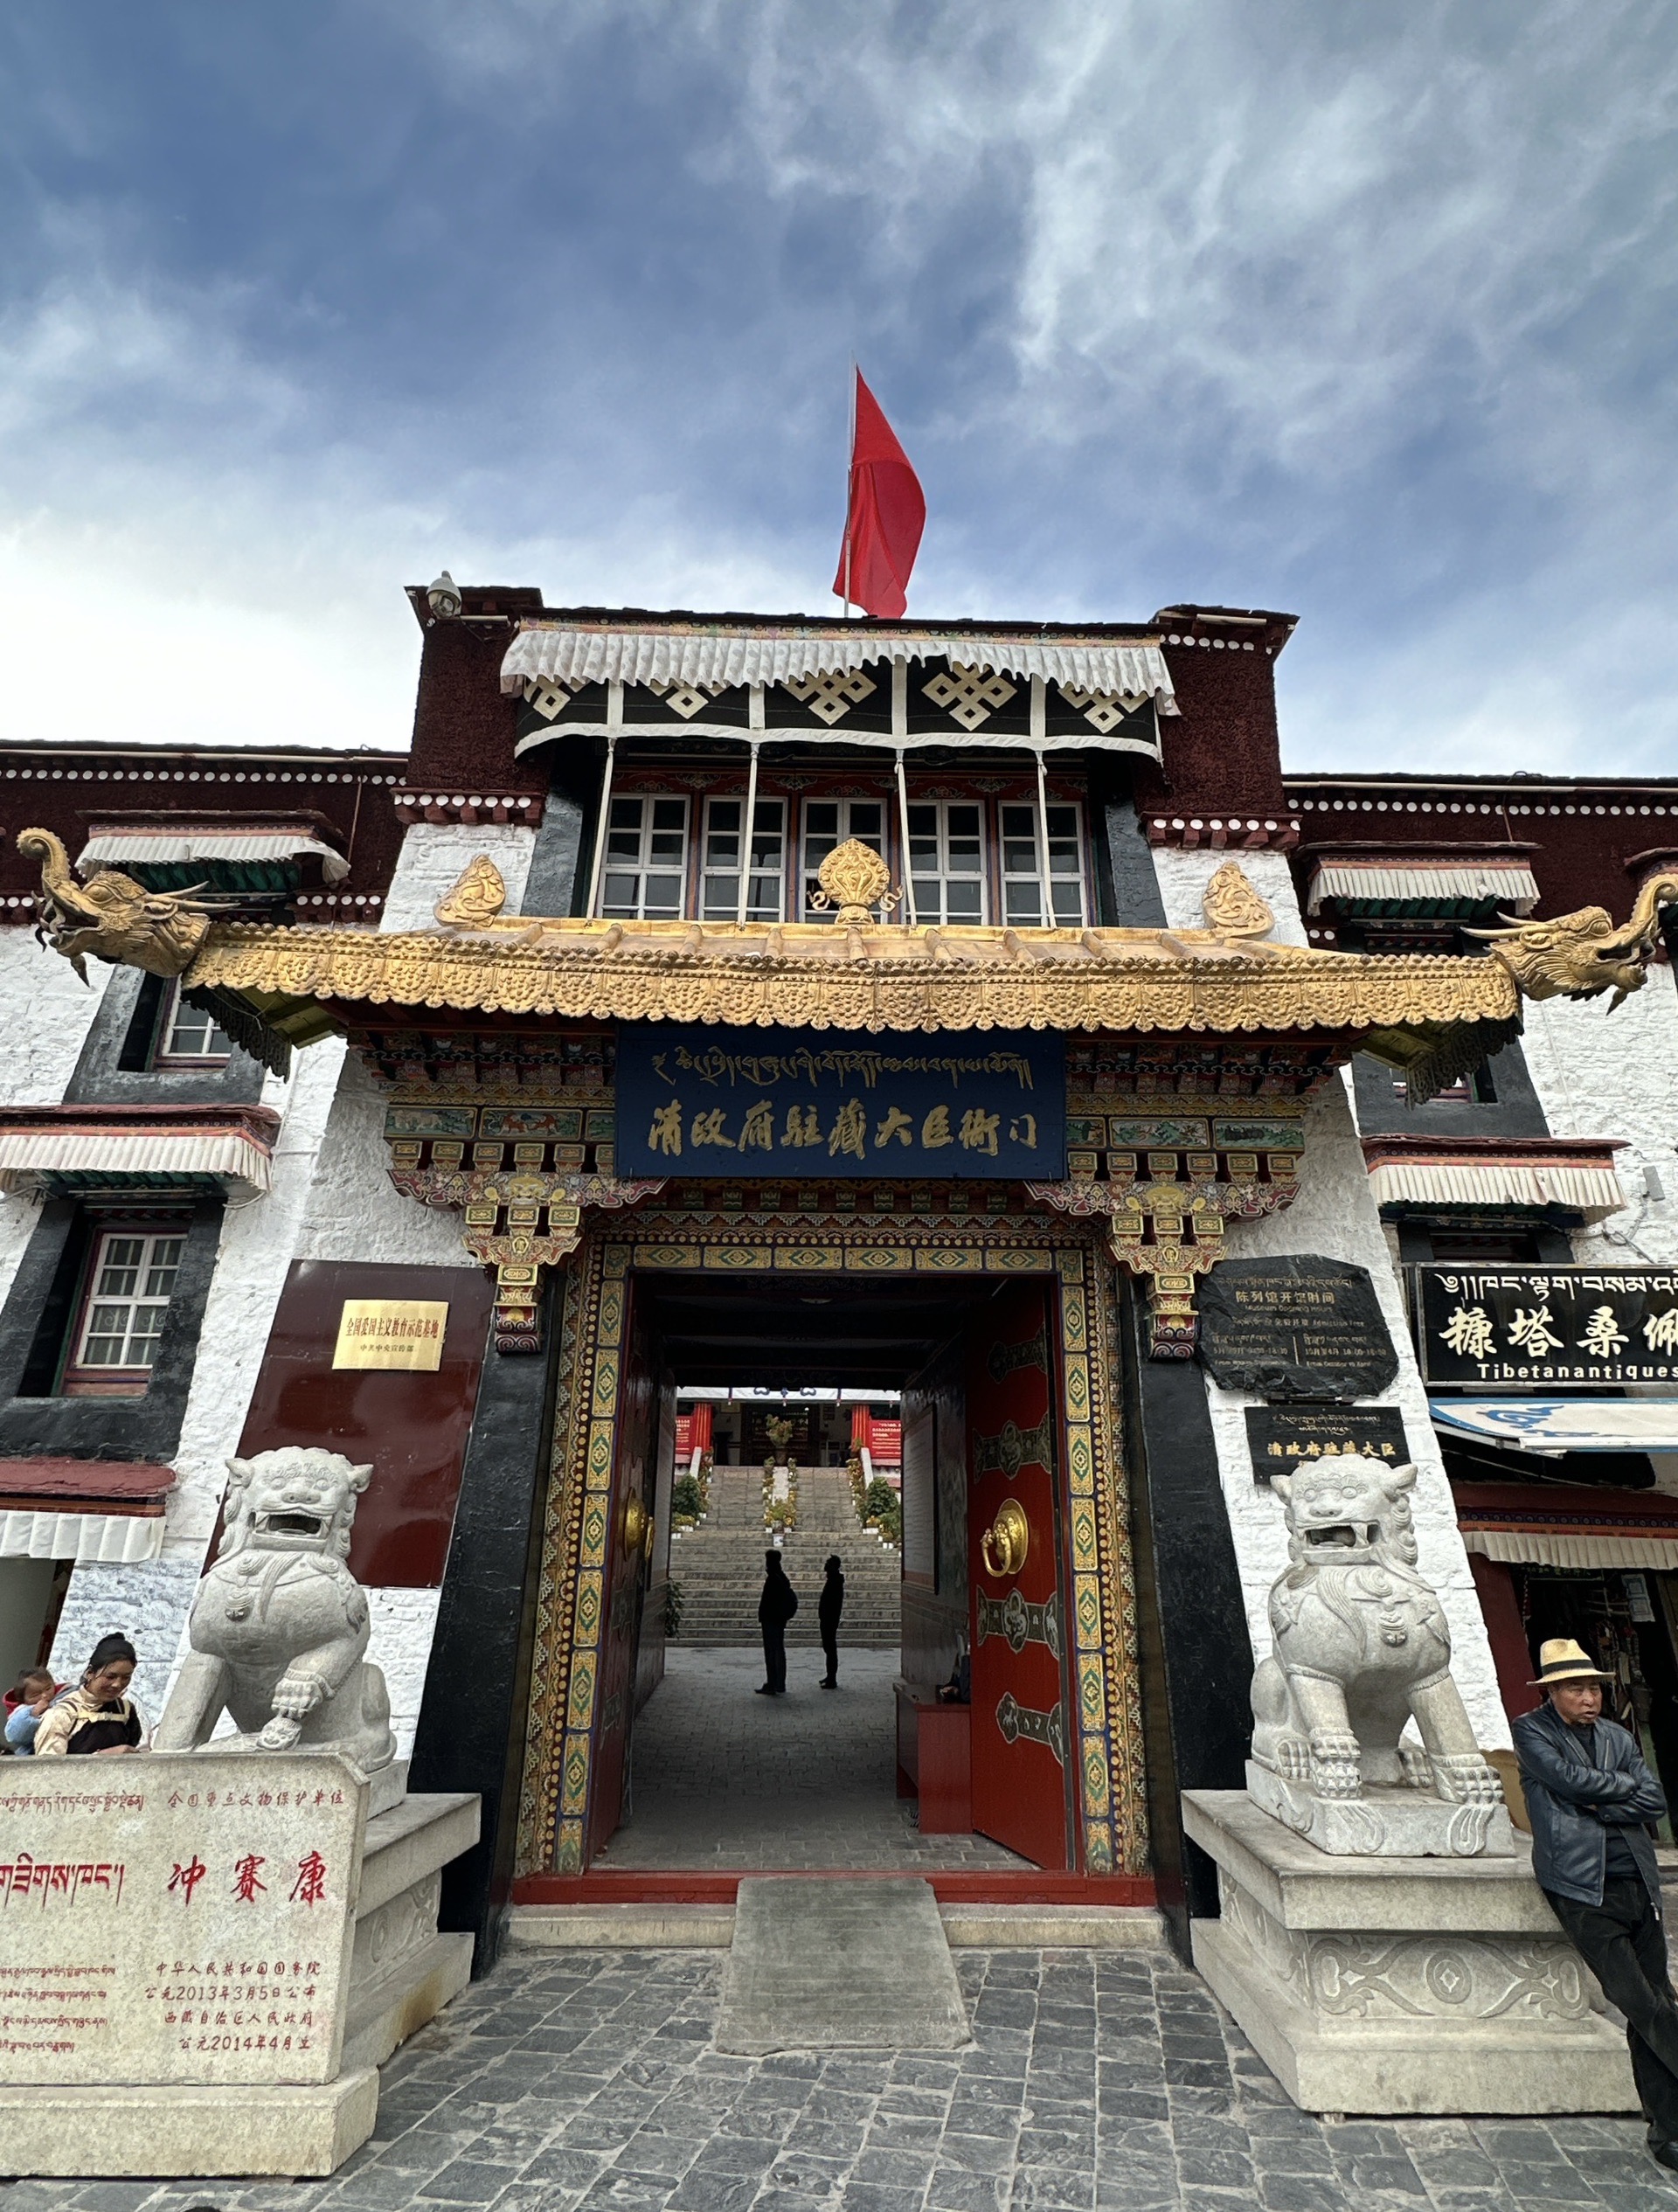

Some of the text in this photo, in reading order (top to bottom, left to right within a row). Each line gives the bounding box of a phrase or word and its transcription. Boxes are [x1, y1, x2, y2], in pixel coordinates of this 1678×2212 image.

[168, 1789, 344, 1807] 全国重点文物保护单位
[167, 1850, 327, 1907] 冲赛康
[156, 1961, 321, 1976] 中华人民共和国国务院
[164, 2010, 313, 2027] 西藏自治区人民政府
